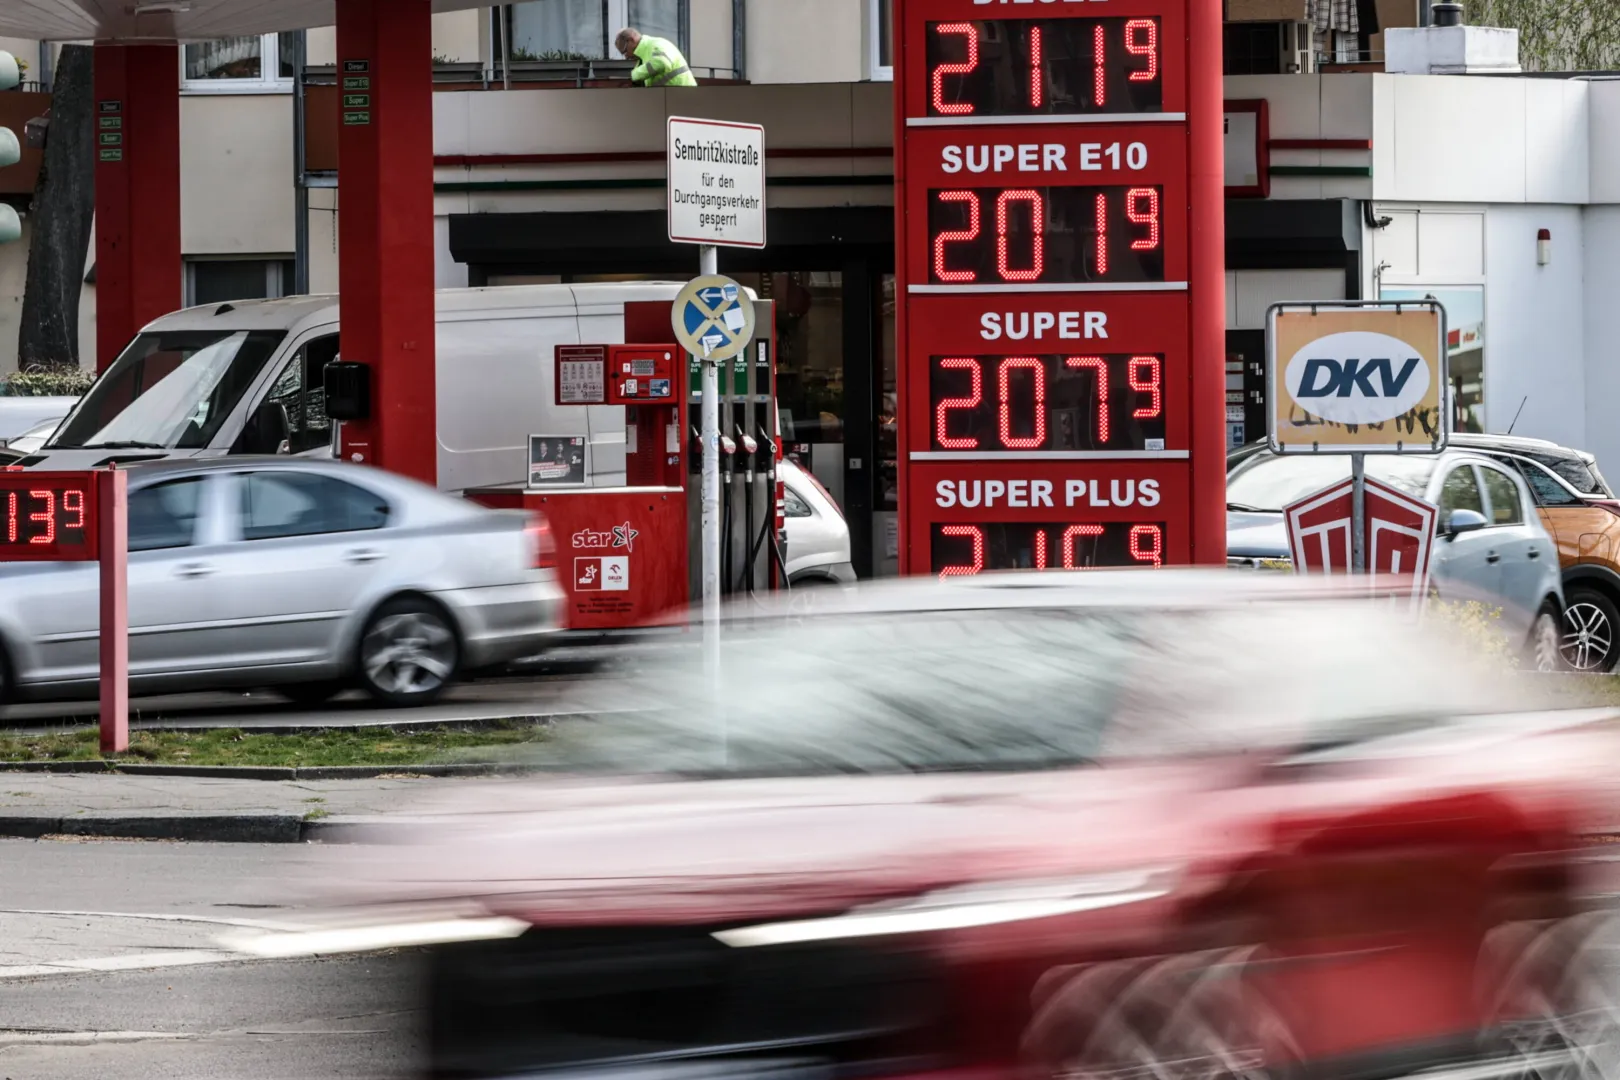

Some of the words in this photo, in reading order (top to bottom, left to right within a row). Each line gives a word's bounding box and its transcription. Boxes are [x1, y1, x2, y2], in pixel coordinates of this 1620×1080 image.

[932, 19, 1157, 114] 2119
[674, 137, 759, 166] Sembritzkistraße
[941, 143, 1067, 174] SUPER
[1079, 141, 1148, 171] E10
[702, 172, 715, 187] für
[718, 174, 735, 189] den
[674, 188, 760, 210] Durchgangsverkehr
[699, 212, 737, 228] gesperrt
[934, 188, 1159, 281] 2019
[979, 310, 1109, 341] SUPER
[619, 383, 627, 396] 1
[1296, 358, 1420, 398] DKV
[936, 356, 1161, 449] 2079
[935, 479, 1054, 508] SUPER
[1065, 478, 1161, 507] PLUS
[572, 528, 611, 548] star
